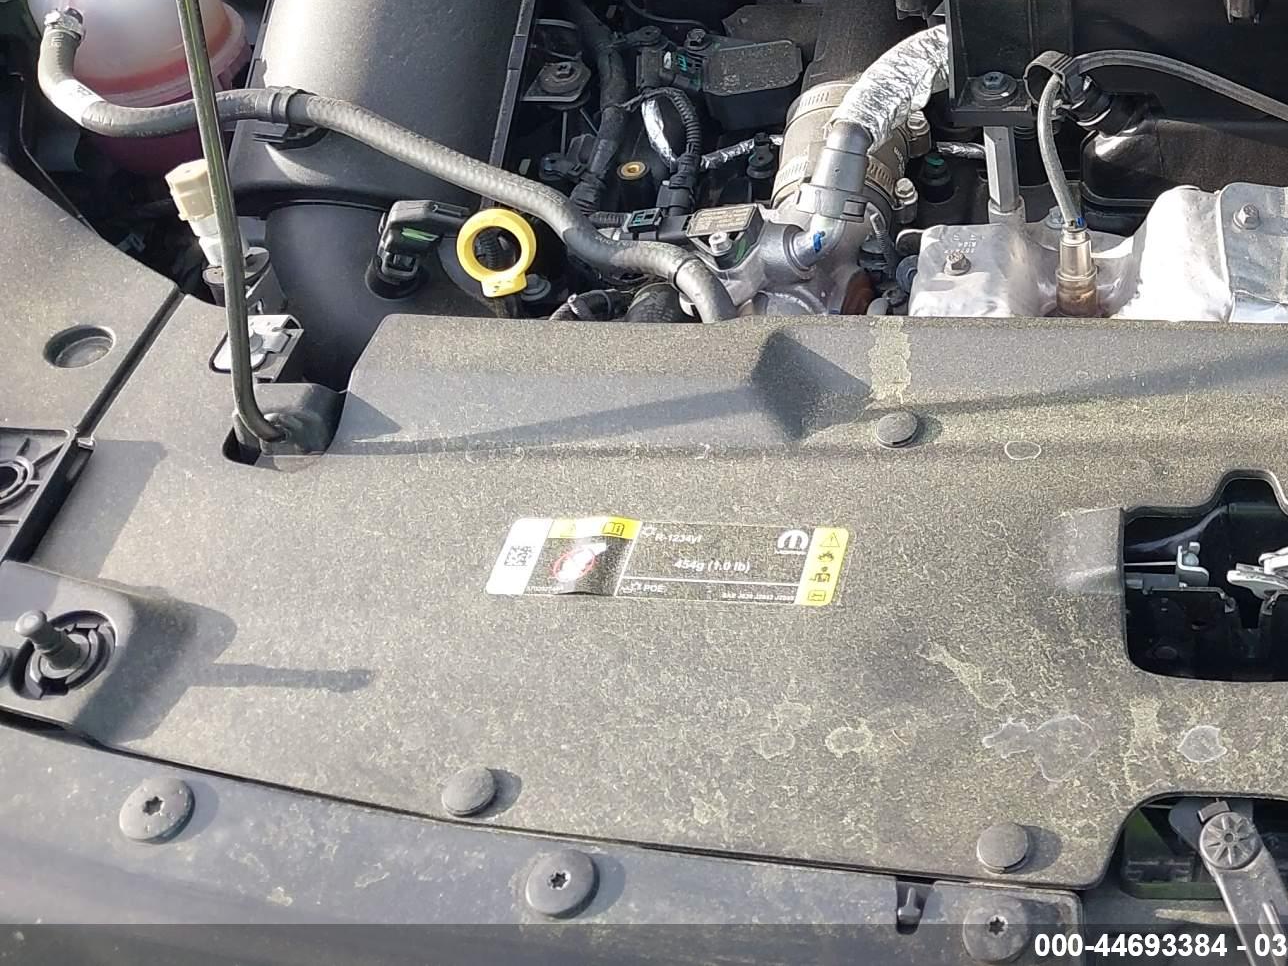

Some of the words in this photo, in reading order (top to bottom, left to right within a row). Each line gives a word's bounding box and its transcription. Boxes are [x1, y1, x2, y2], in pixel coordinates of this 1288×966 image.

[655, 534, 702, 544] R-1234yf
[674, 559, 704, 572] 454g
[707, 560, 732, 572] (1.0
[734, 561, 751, 574] lb)
[643, 584, 665, 593] POE
